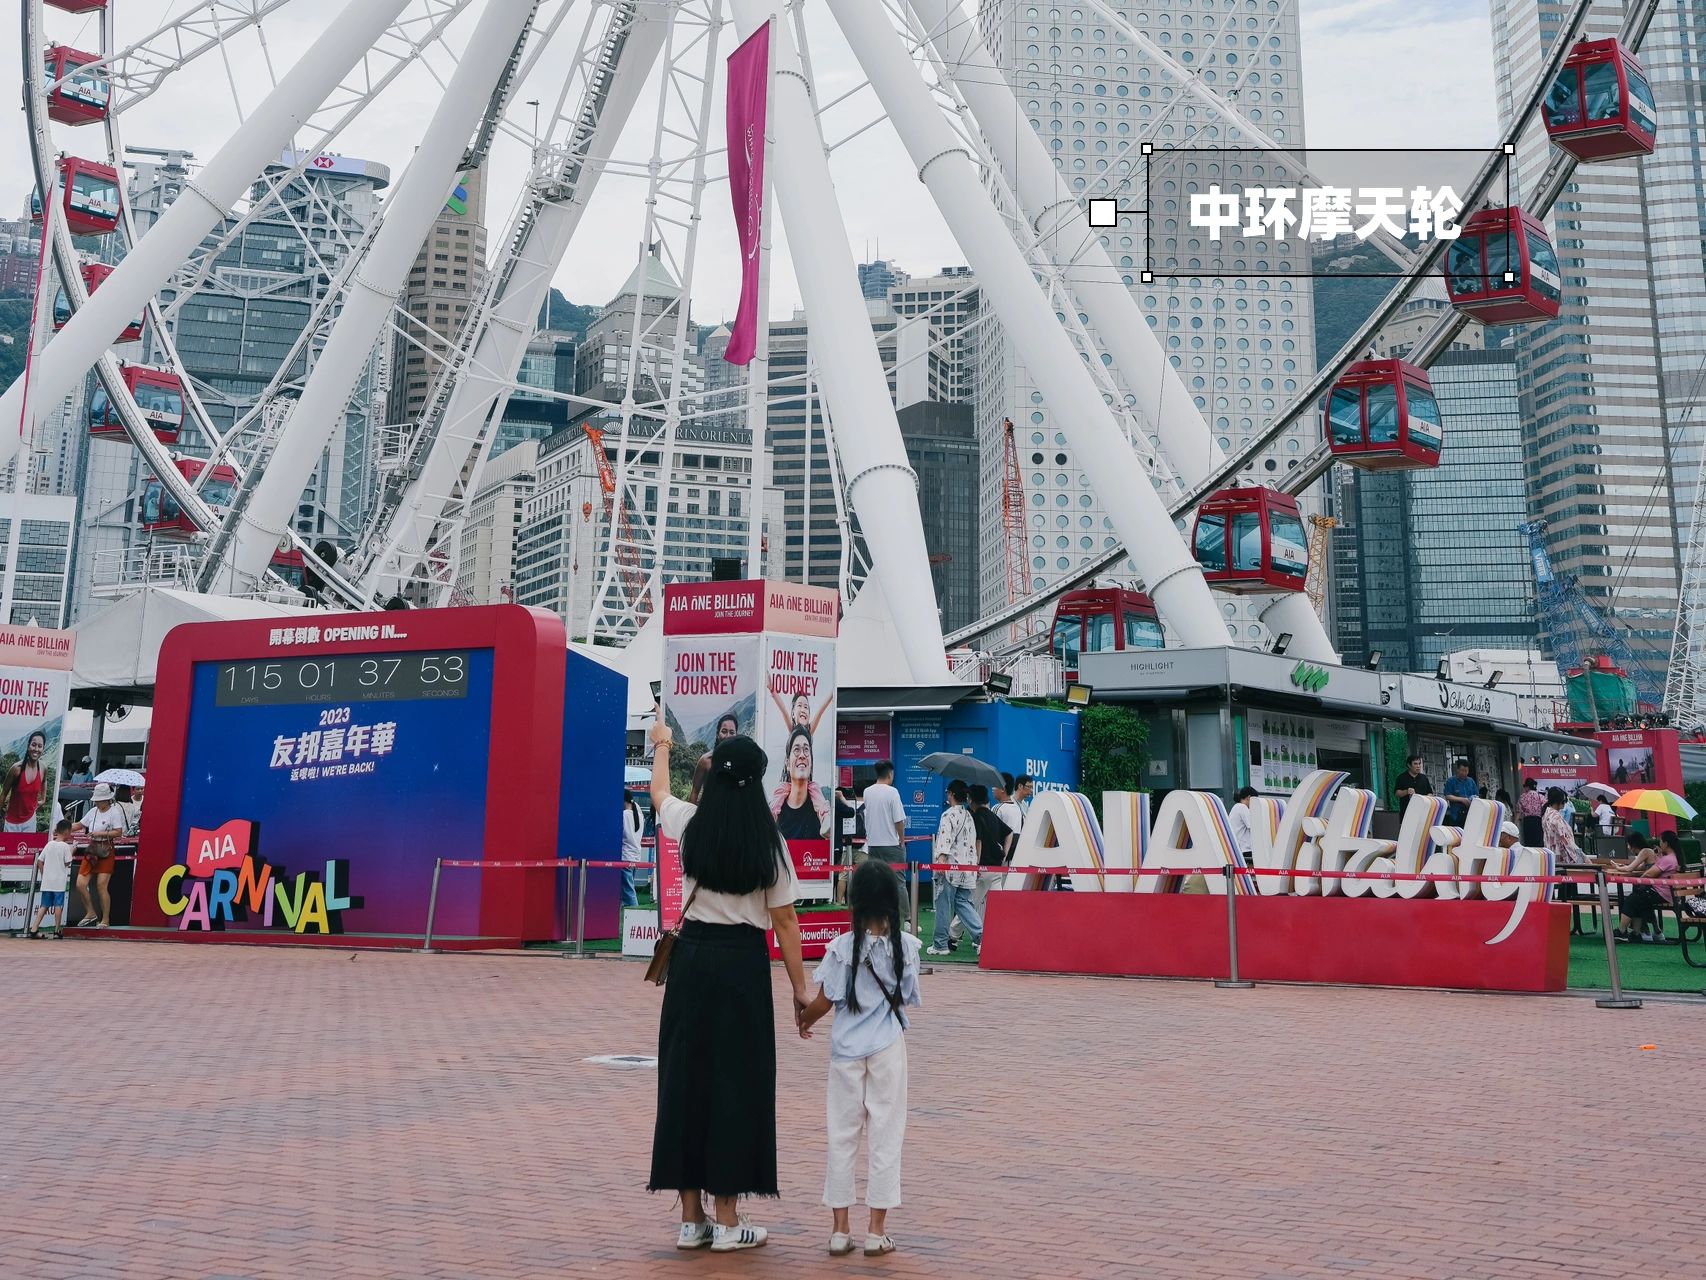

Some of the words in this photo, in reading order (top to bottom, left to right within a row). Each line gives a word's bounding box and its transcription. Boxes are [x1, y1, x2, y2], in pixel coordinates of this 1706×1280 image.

[78, 86, 91, 95] AIA
[88, 199, 102, 207] AIA
[150, 411, 163, 420] AIA
[1420, 422, 1430, 432] AIA
[1284, 549, 1295, 560] AIA
[669, 596, 688, 612] AIA
[770, 593, 784, 610] AIA
[734, 610, 754, 618] JOURNEY
[0, 633, 15, 646] AIA
[269, 627, 320, 646] 開幕倒數
[324, 625, 379, 642] OPENING
[675, 653, 705, 672] JOIN
[708, 652, 736, 671] THE
[771, 649, 794, 671] JOIN
[797, 651, 818, 673] THE
[1130, 661, 1174, 670] HIGHLIGHT
[225, 664, 282, 691] 115
[298, 662, 335, 688] 01
[358, 659, 402, 686] 37
[420, 656, 464, 683] 53
[0, 679, 23, 697] OIN
[27, 681, 49, 698] THE
[673, 675, 737, 696] JOURNEY
[770, 673, 819, 697] JOURNEY
[240, 696, 260, 704] DAYS
[305, 694, 331, 702] HOURS
[362, 691, 395, 699] MINUTES
[422, 689, 460, 697] SECONDS
[0, 698, 49, 717] OURNEY
[319, 707, 351, 726] 2023
[269, 721, 397, 769] 友邦嘉年華
[322, 763, 347, 778] WE'RE
[349, 761, 375, 775] BACK!
[1026, 758, 1048, 777] BUY
[1032, 780, 1070, 797] ICKETS
[198, 833, 237, 864] AIA
[1003, 789, 1253, 895] AIA
[1250, 769, 1555, 945] Vitality
[158, 854, 350, 934] CARNIVAL
